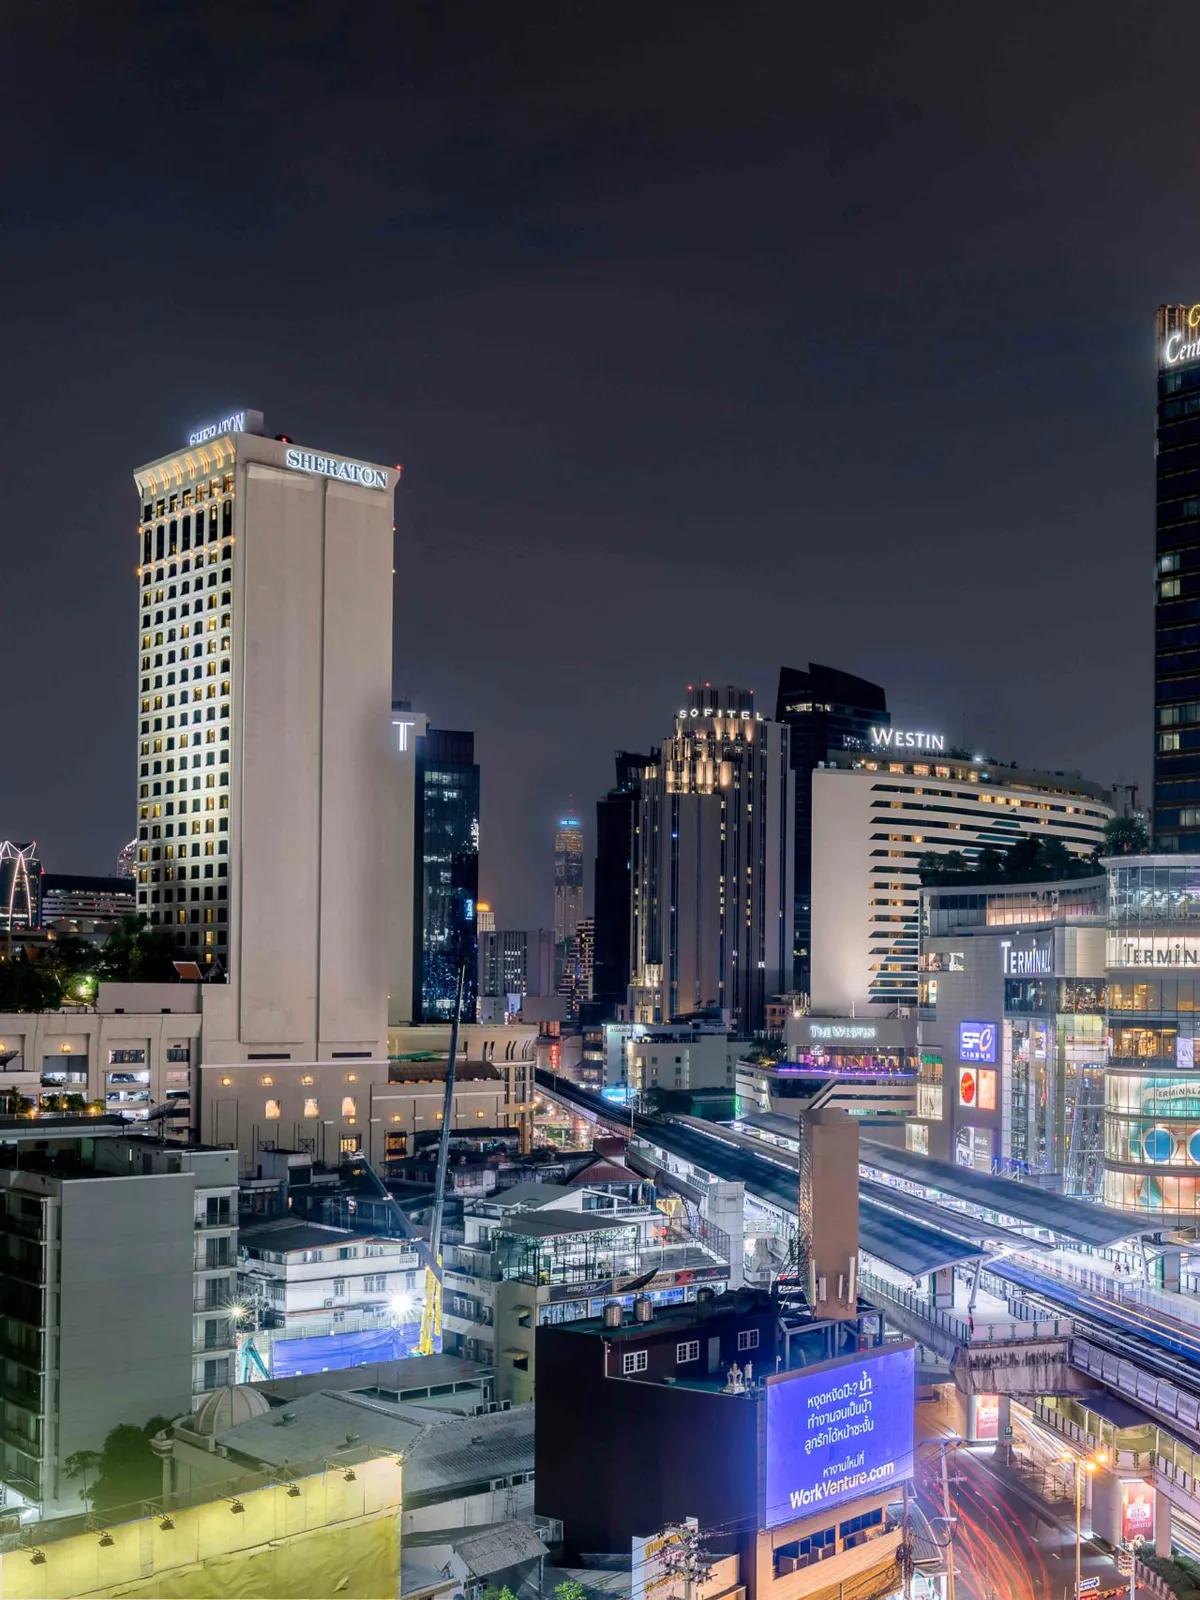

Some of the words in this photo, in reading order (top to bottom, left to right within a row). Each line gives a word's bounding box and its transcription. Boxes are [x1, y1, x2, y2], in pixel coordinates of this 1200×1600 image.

[286, 450, 388, 488] SHERATON
[679, 709, 763, 721] SOFITEL
[872, 727, 944, 750] WESTIN
[810, 1025, 832, 1038] THE
[832, 1025, 876, 1039] WESTIN
[789, 1462, 894, 1510] WorkVenture.com
